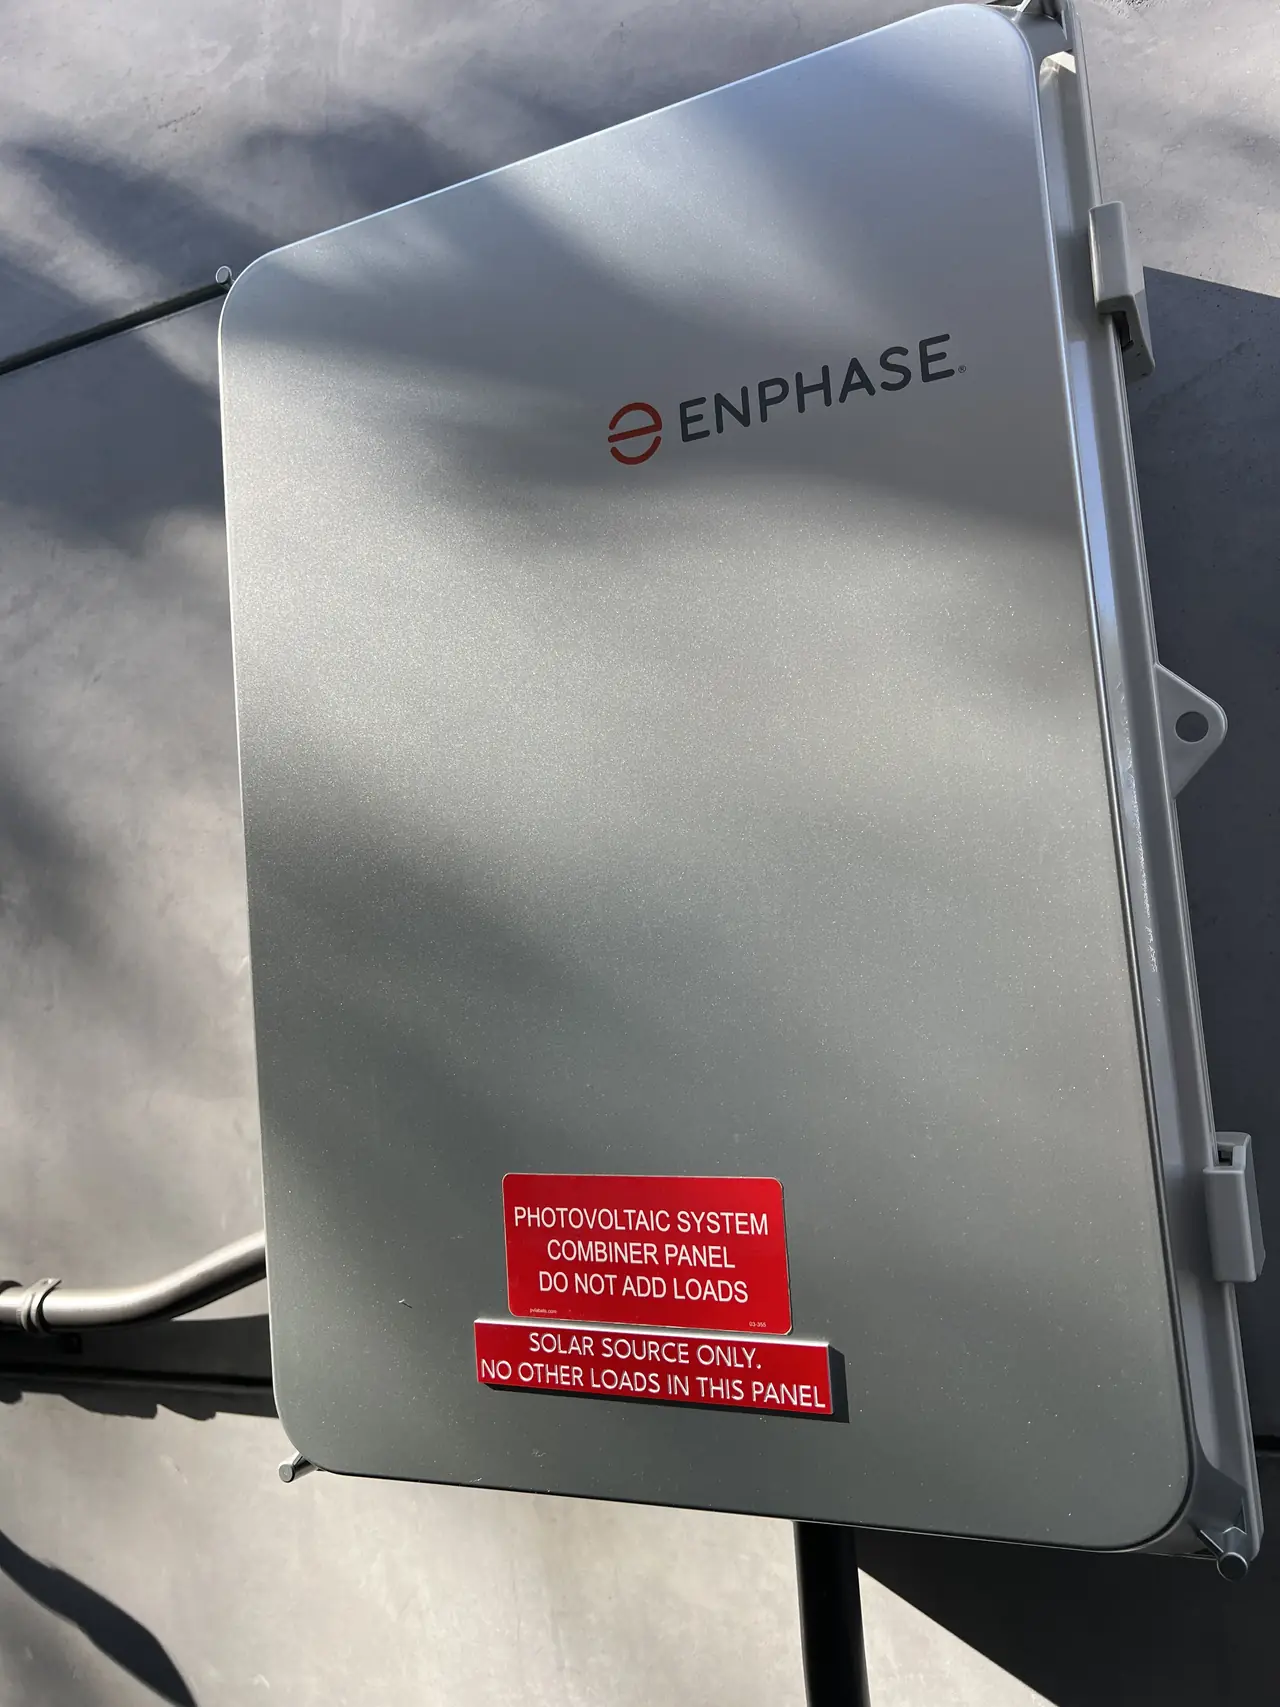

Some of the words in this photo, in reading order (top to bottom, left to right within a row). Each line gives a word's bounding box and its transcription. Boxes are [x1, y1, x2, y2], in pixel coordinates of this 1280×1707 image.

[679, 333, 955, 443] ENPHASE
[514, 1206, 671, 1233] PHOTOVOLTAIC
[677, 1210, 768, 1235] SYSTEM
[547, 1239, 658, 1265] COMBINER
[665, 1243, 736, 1269] PANEL
[539, 1271, 568, 1293] DO
[575, 1273, 617, 1296] NOT
[622, 1276, 666, 1298] ADD
[674, 1279, 749, 1304] LOADS
[529, 1332, 595, 1356] SOLAR
[601, 1337, 690, 1364] SOURCE
[697, 1344, 762, 1370] ONLY.
[480, 1359, 512, 1380] NO
[518, 1362, 584, 1388] OTHER
[591, 1368, 661, 1394] LOADS
[667, 1373, 690, 1397] IN
[696, 1376, 745, 1401] THIS
[752, 1381, 827, 1408] PANEL
